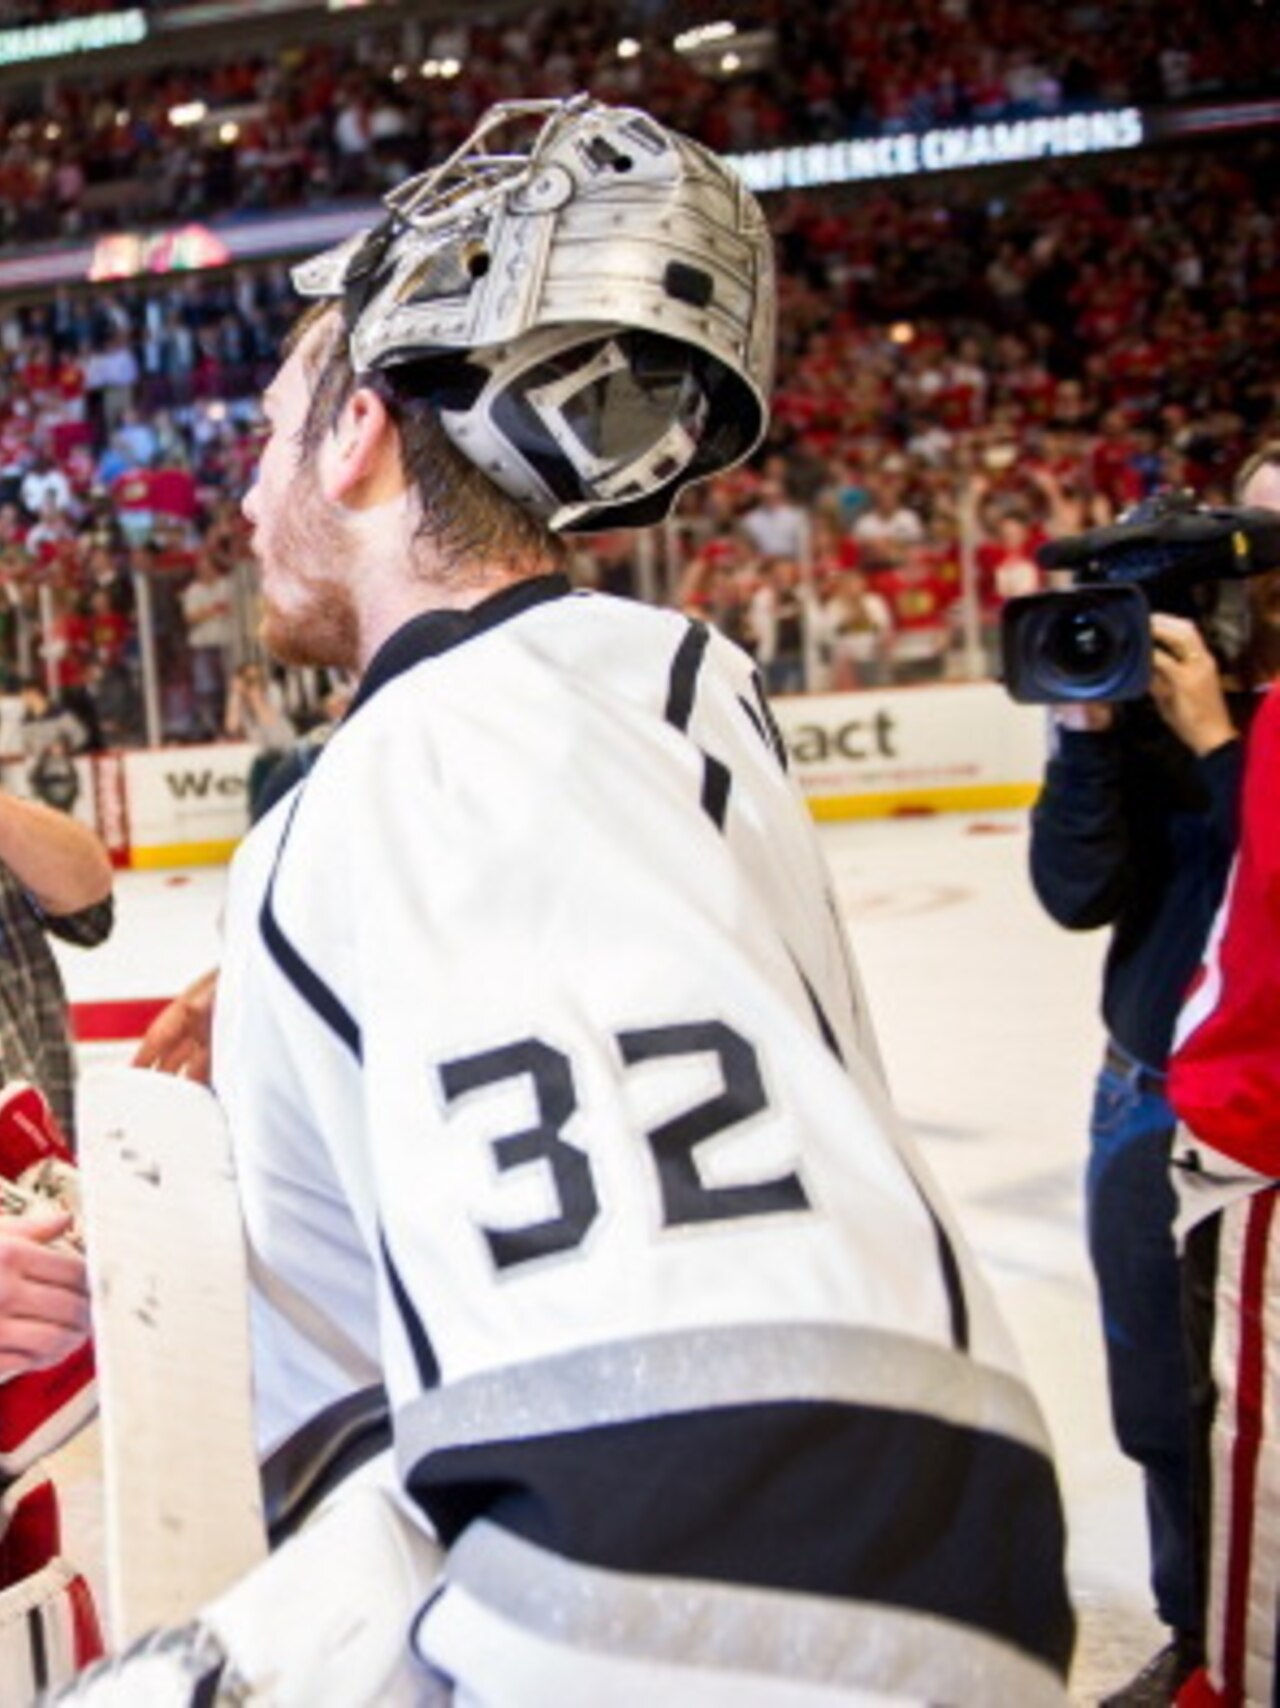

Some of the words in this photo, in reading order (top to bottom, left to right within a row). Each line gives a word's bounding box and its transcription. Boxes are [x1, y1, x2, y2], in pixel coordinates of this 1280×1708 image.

[920, 108, 1142, 170] CHAMPIONS
[789, 708, 898, 765] act
[432, 1016, 814, 1279] 32
